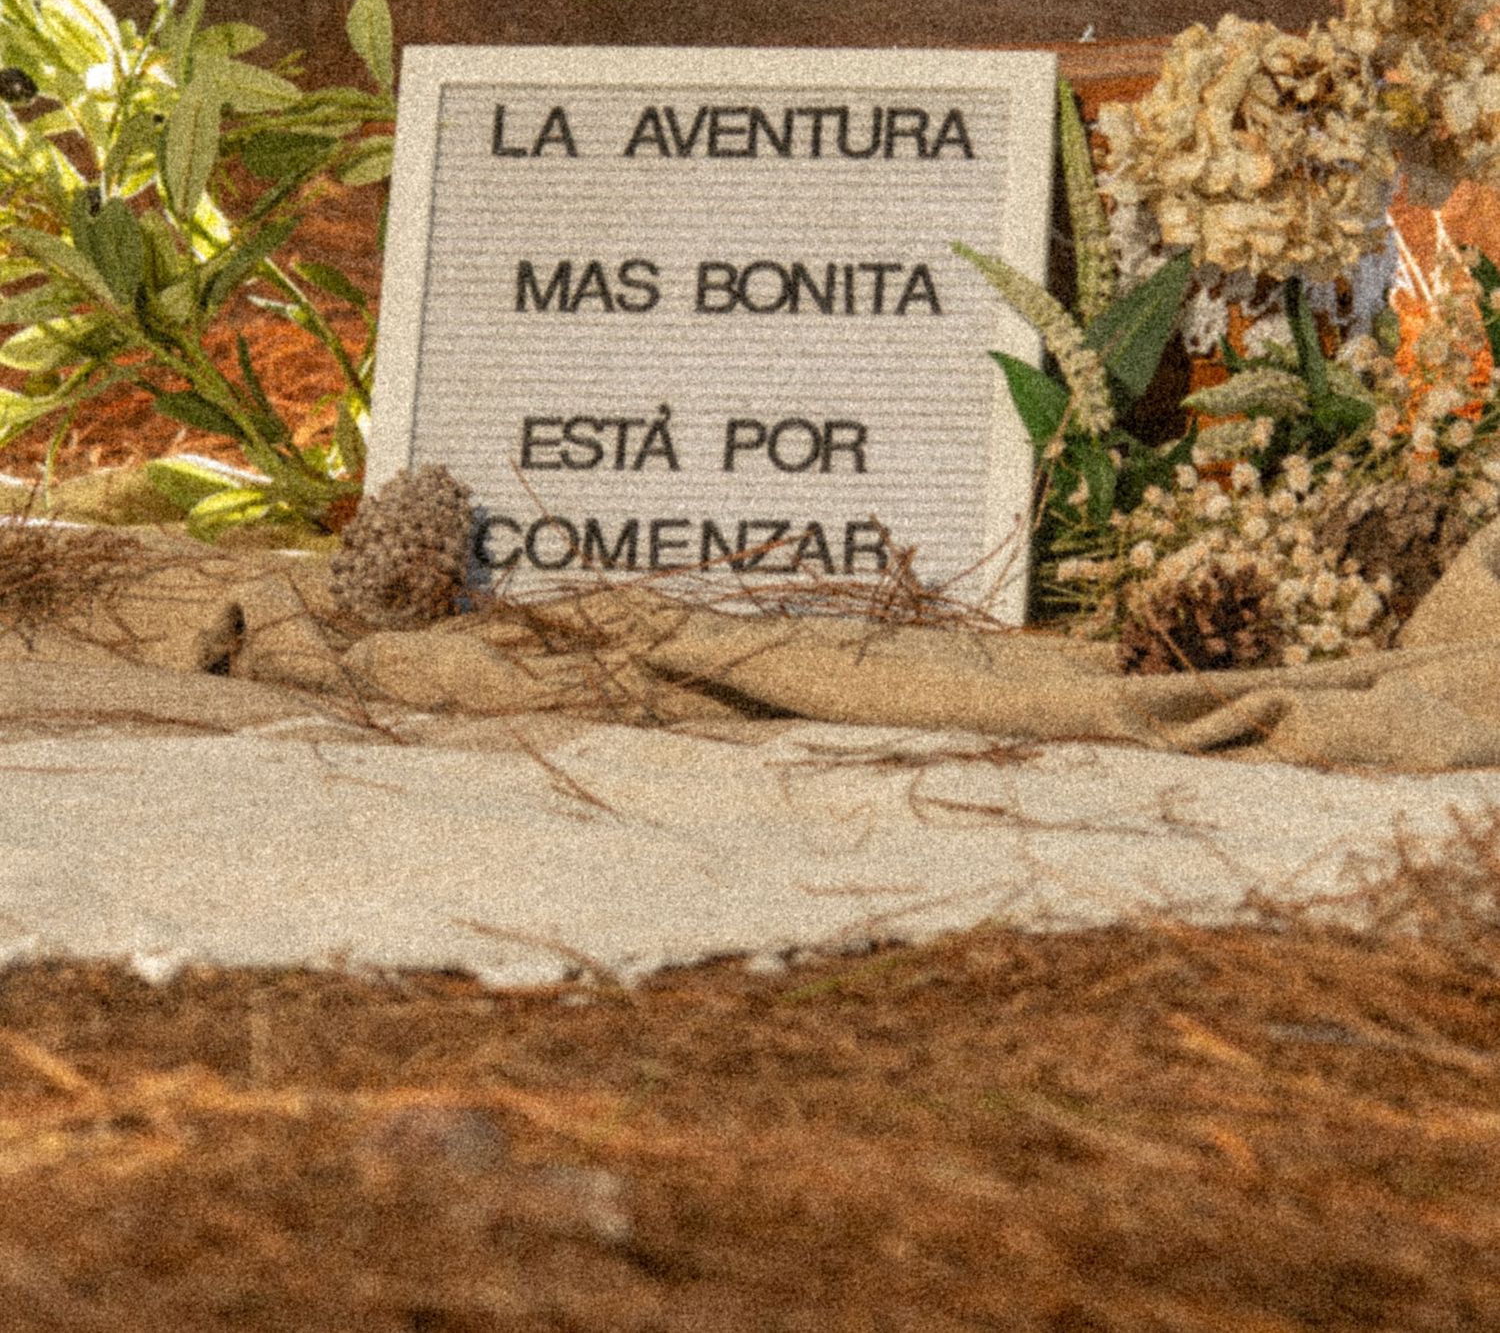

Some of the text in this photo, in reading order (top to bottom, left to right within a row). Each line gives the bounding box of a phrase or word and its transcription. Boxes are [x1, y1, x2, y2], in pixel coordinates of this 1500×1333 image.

[491, 104, 976, 162] LA AVENTURA
[514, 259, 943, 316] MAS BONITA
[520, 403, 868, 474] ESTÁ POR
[473, 516, 891, 576] COMENZAR
